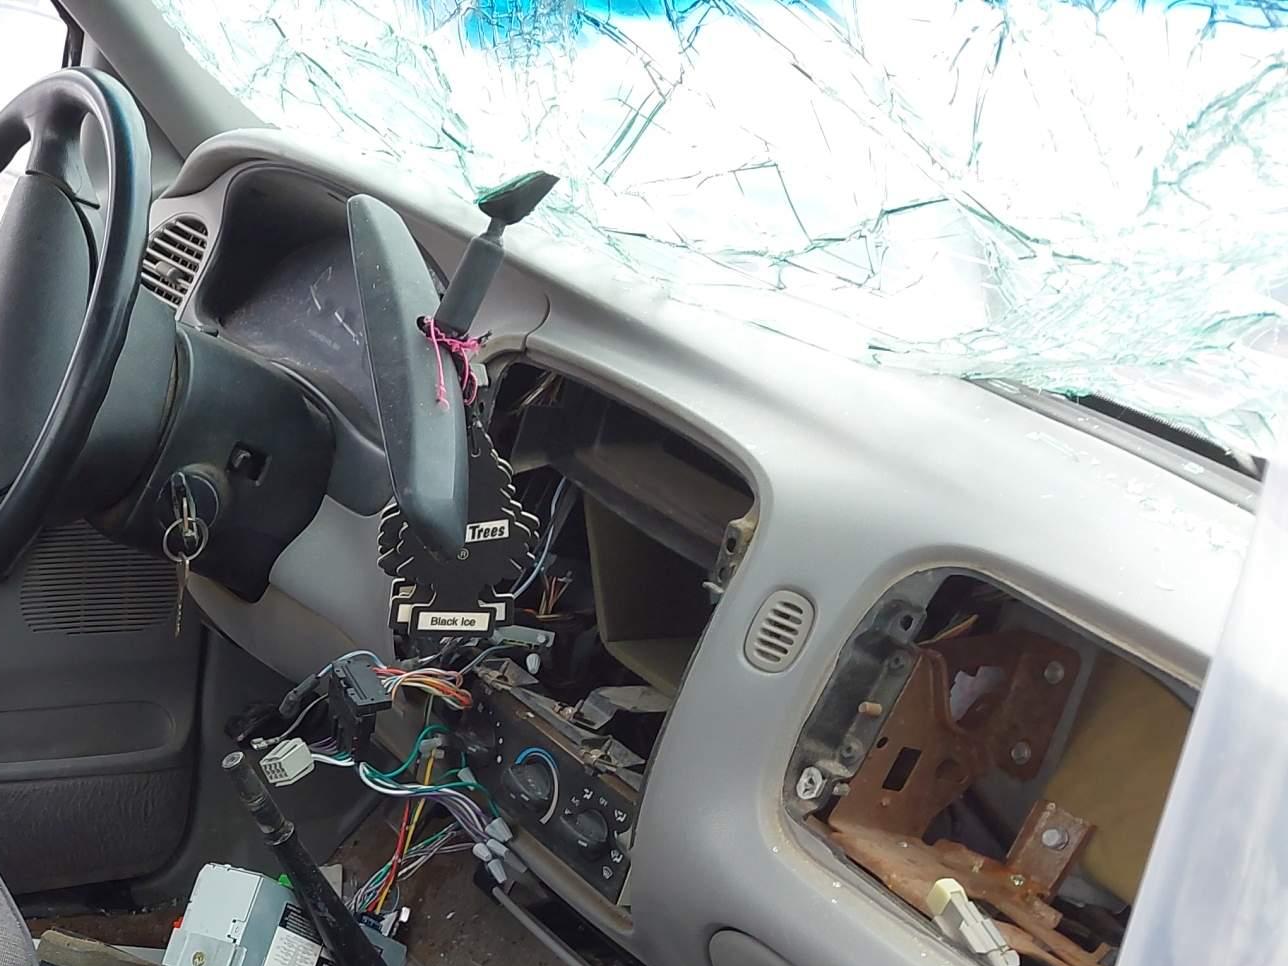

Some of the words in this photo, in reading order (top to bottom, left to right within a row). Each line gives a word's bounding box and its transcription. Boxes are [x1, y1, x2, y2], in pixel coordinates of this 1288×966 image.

[468, 524, 505, 540] Trees
[430, 616, 458, 626] Black
[460, 616, 476, 626] Ice
